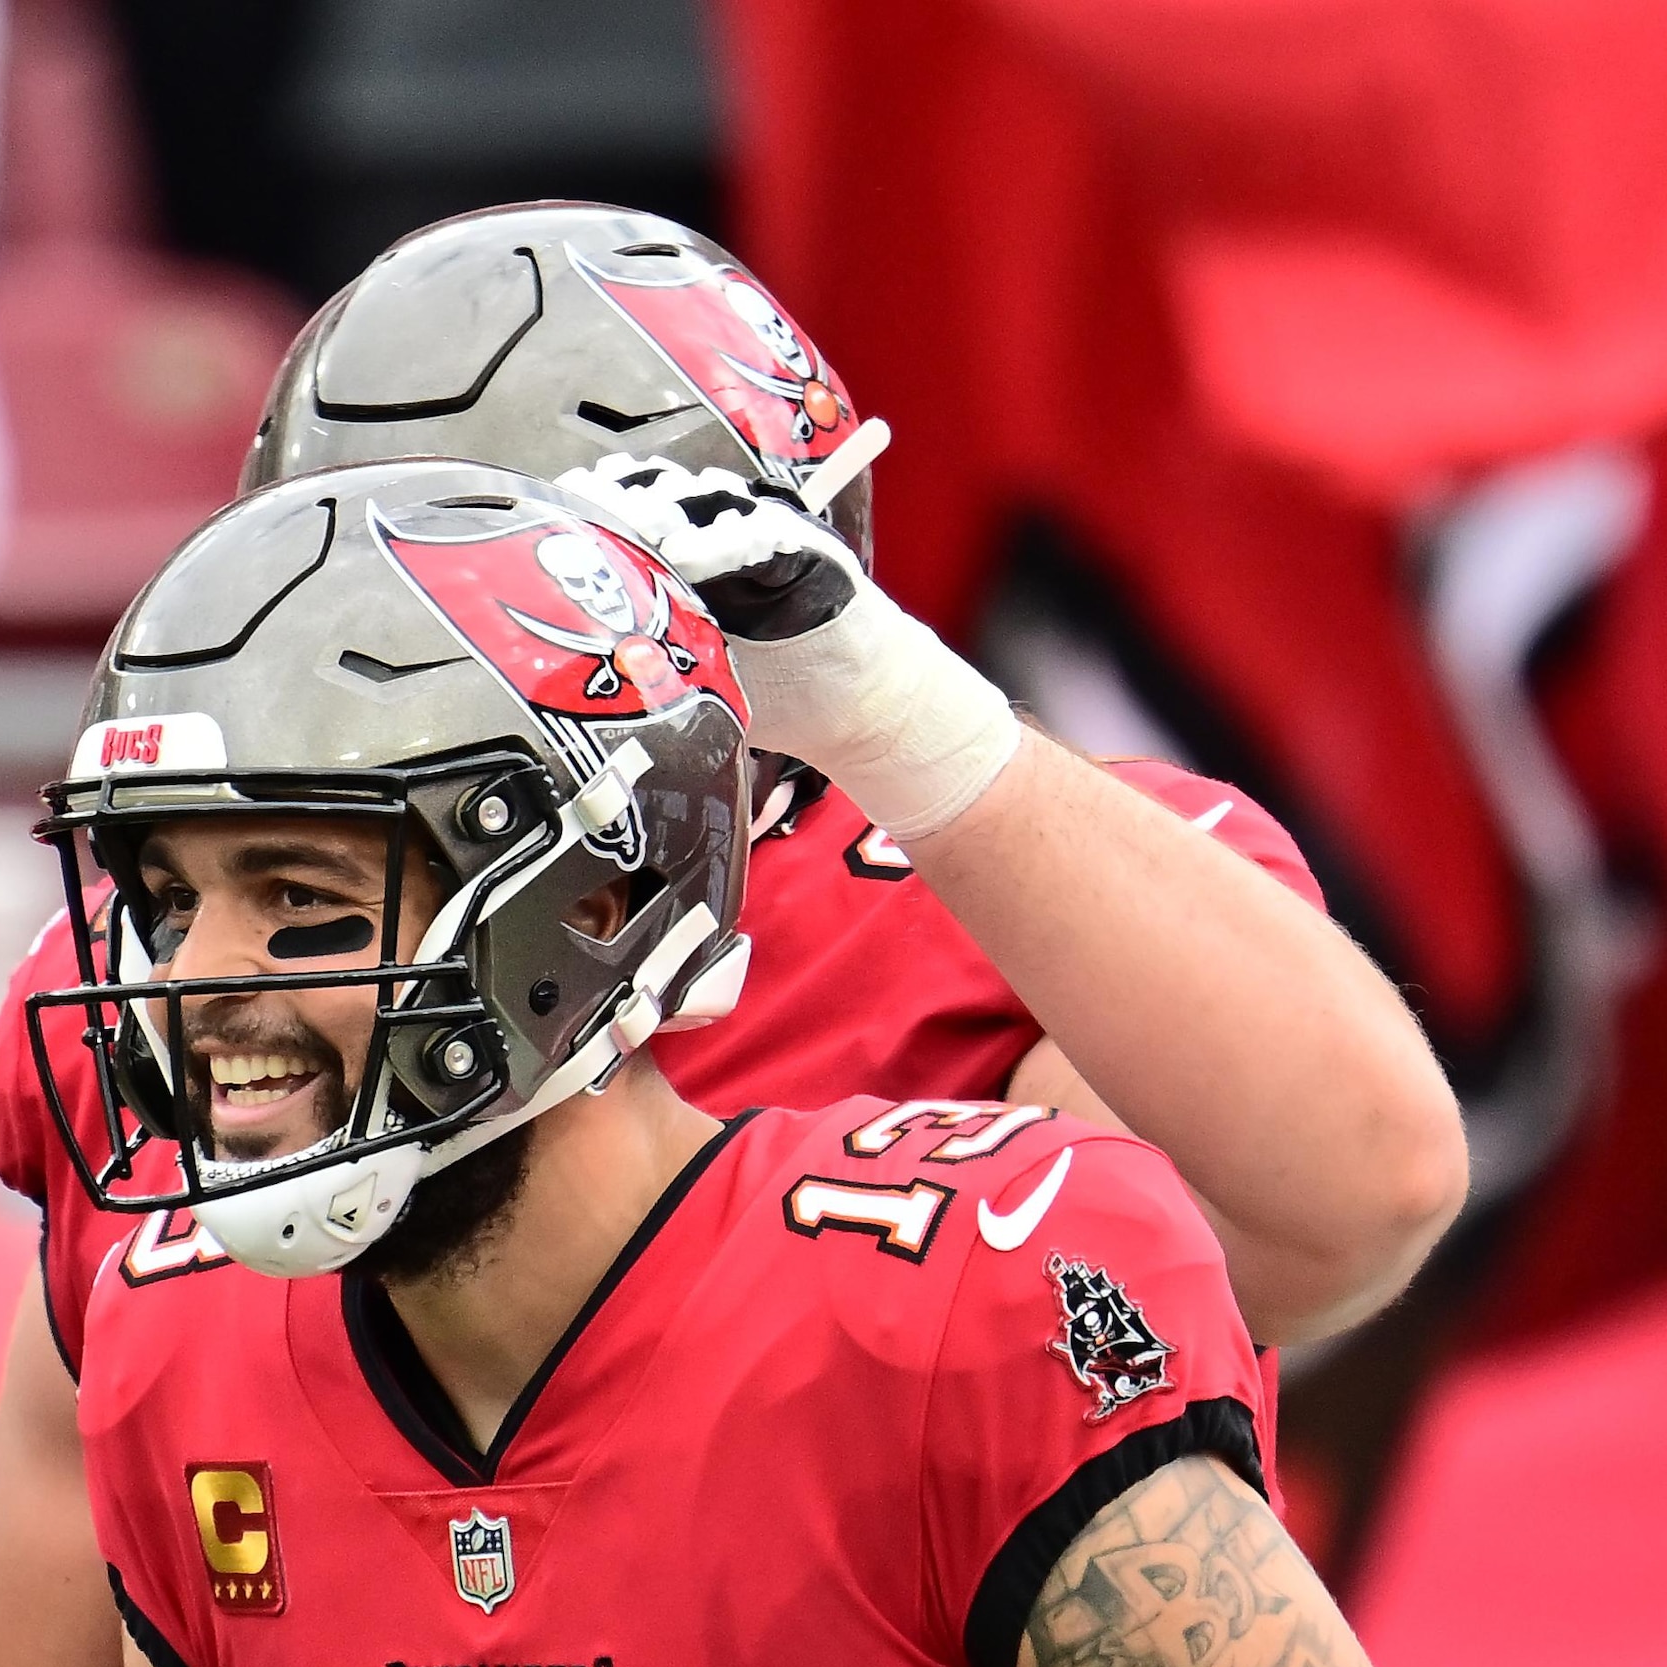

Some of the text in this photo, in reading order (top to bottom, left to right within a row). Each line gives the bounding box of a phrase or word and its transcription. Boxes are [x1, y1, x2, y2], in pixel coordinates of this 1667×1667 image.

[100, 724, 163, 769] BUCS
[782, 1099, 1059, 1265] 13
[191, 1470, 269, 1575] C
[460, 1557, 504, 1596] NFL
